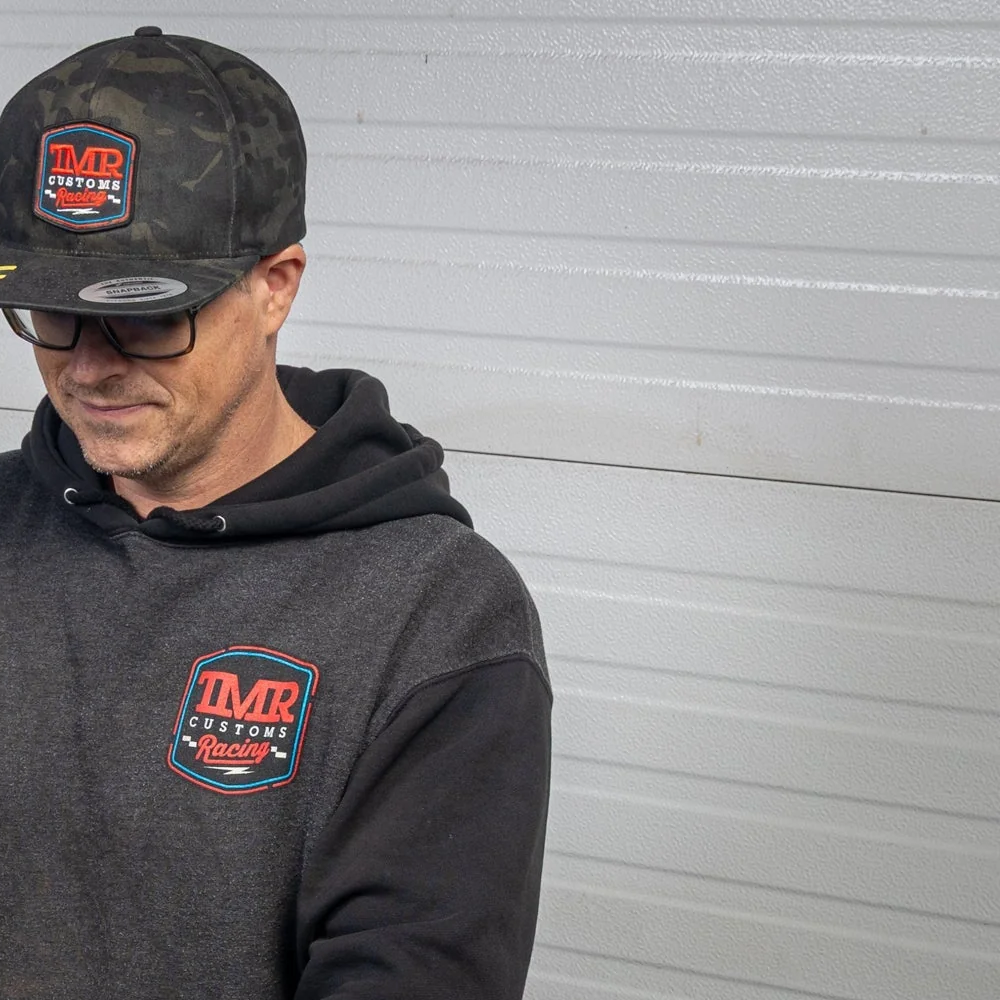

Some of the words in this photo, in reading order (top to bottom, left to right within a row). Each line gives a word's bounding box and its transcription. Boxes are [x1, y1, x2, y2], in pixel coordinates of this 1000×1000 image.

[49, 143, 124, 178] TMR
[48, 175, 121, 191] CUSTOMS
[55, 188, 108, 208] Racing
[105, 285, 161, 295] SNAPBACK
[195, 670, 300, 723] TMR
[189, 716, 288, 738] CUSTOMS
[195, 734, 271, 765] Racing
